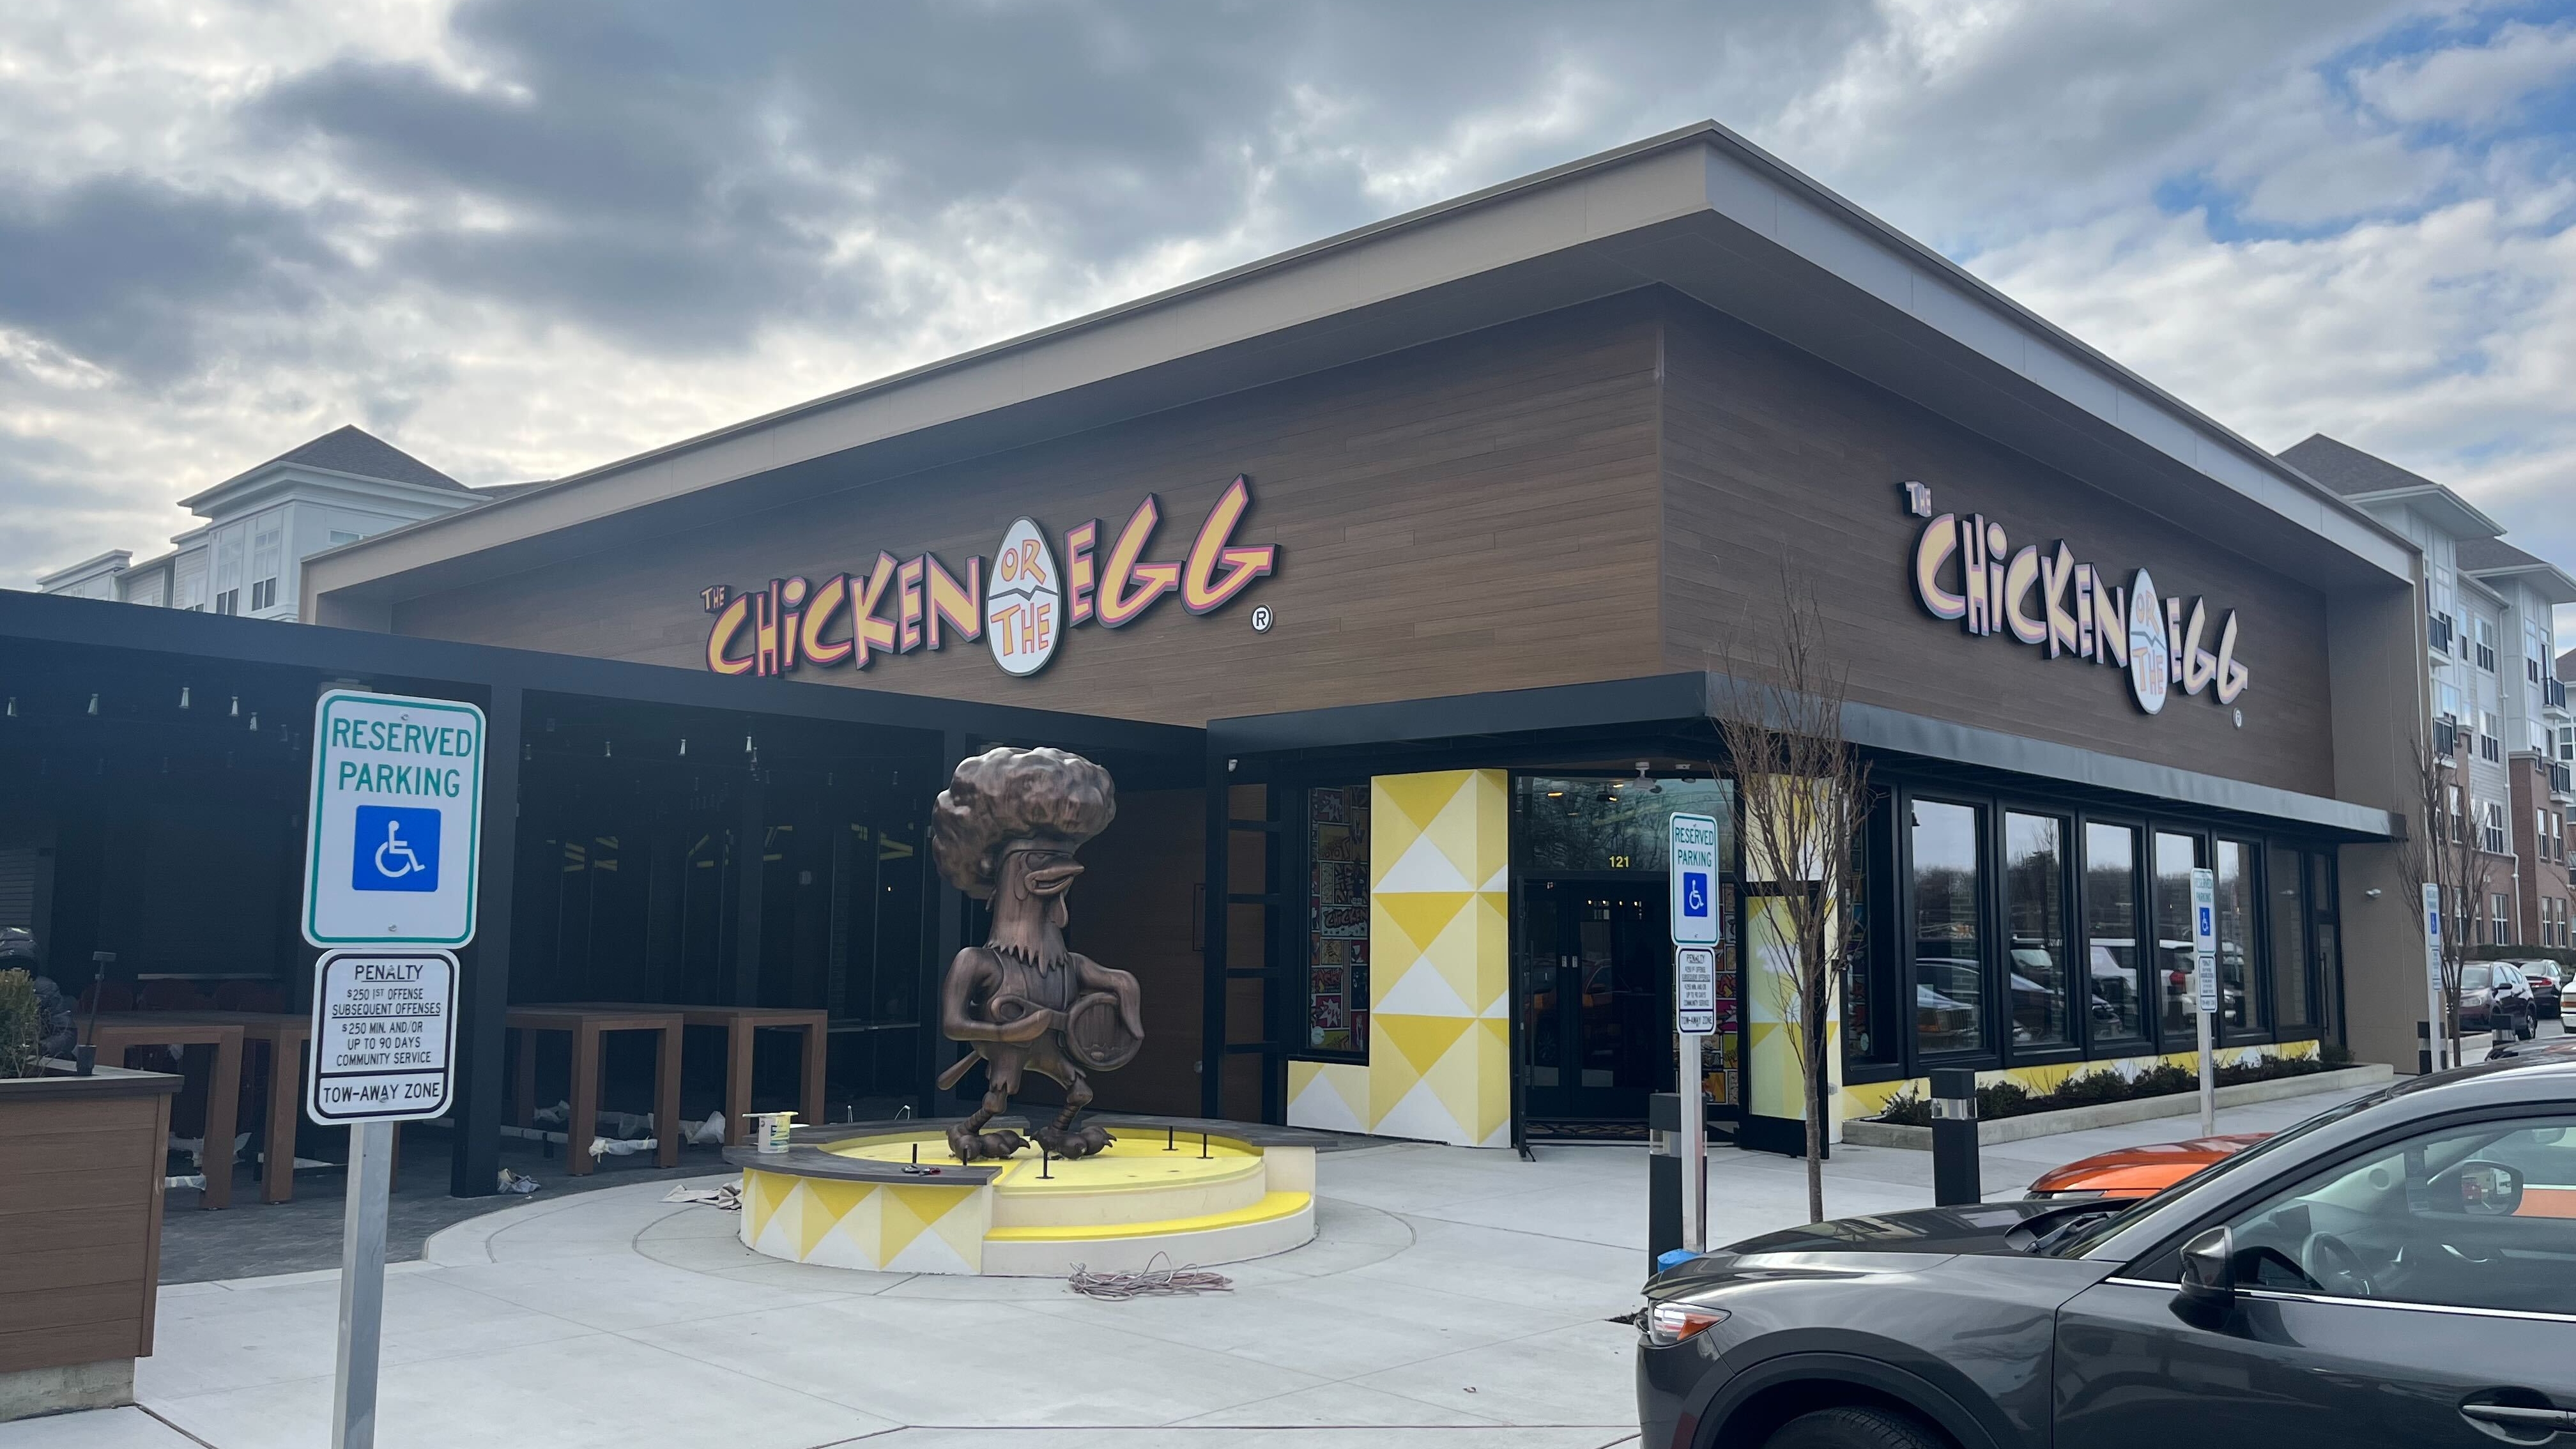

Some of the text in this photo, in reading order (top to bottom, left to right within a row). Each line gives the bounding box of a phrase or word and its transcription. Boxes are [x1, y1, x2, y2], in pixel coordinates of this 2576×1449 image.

[1904, 481, 1932, 517] THE
[1000, 538, 1046, 586] OR
[1064, 473, 1280, 628] EGG
[700, 584, 730, 612] THE
[2135, 590, 2159, 636] OR
[990, 602, 1050, 657] THE
[2166, 595, 2248, 705] EGG
[2132, 645, 2163, 696] THE
[332, 717, 472, 758] RESERVED
[339, 761, 461, 798] PARKING
[1675, 827, 1713, 845] RESERVED
[1609, 856, 1629, 868] 121
[1678, 849, 1712, 867] PARKING
[355, 965, 424, 980] PENALTY
[347, 988, 424, 1001] $250 1ST OFFENSE
[332, 1002, 441, 1016] SUBSEQUENT OFFENSES
[342, 1021, 423, 1034] $250 MIN. AND/OR
[348, 1036, 421, 1050] UP TO 90 DAYS
[337, 1051, 431, 1066] COMMUNITY SERVICE
[324, 1082, 440, 1103] TOW-AWAY ZONE
